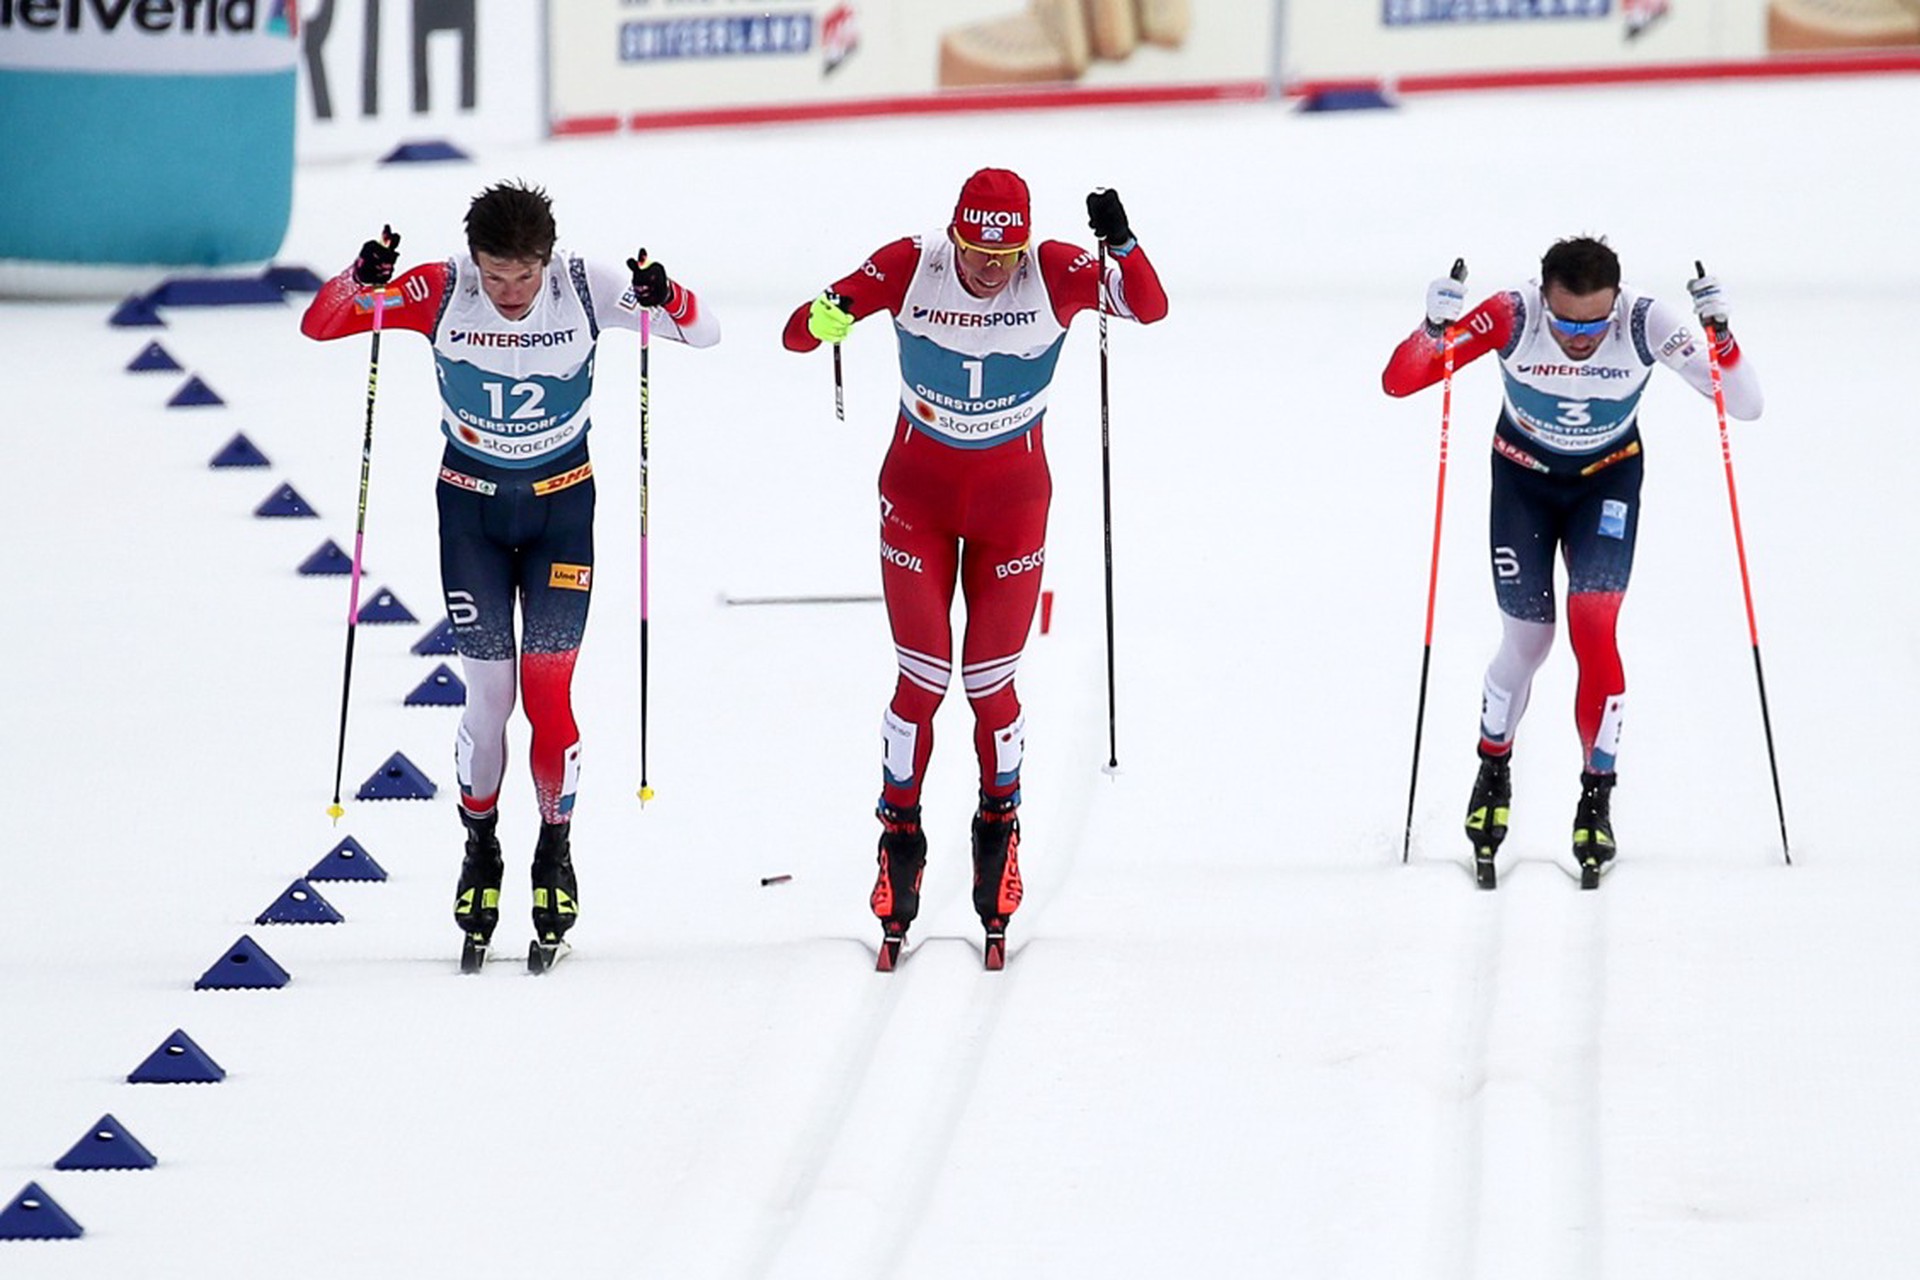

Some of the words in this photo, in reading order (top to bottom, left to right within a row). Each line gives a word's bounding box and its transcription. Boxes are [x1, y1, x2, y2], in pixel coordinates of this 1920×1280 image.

[963, 208, 1024, 226] LUKOIL
[928, 310, 1038, 327] INTERSPORT
[467, 329, 575, 348] INTERSPORT
[962, 361, 983, 399] 1
[1532, 364, 1631, 379] INTERSPORT
[482, 382, 545, 419] 12
[916, 384, 1017, 412] OBERSTDORF
[458, 408, 558, 433] OBERSTDORF
[1517, 406, 1616, 435] OBERSTDORF
[1556, 402, 1591, 426] 3
[441, 467, 476, 489] PAR
[548, 464, 592, 490] DHL
